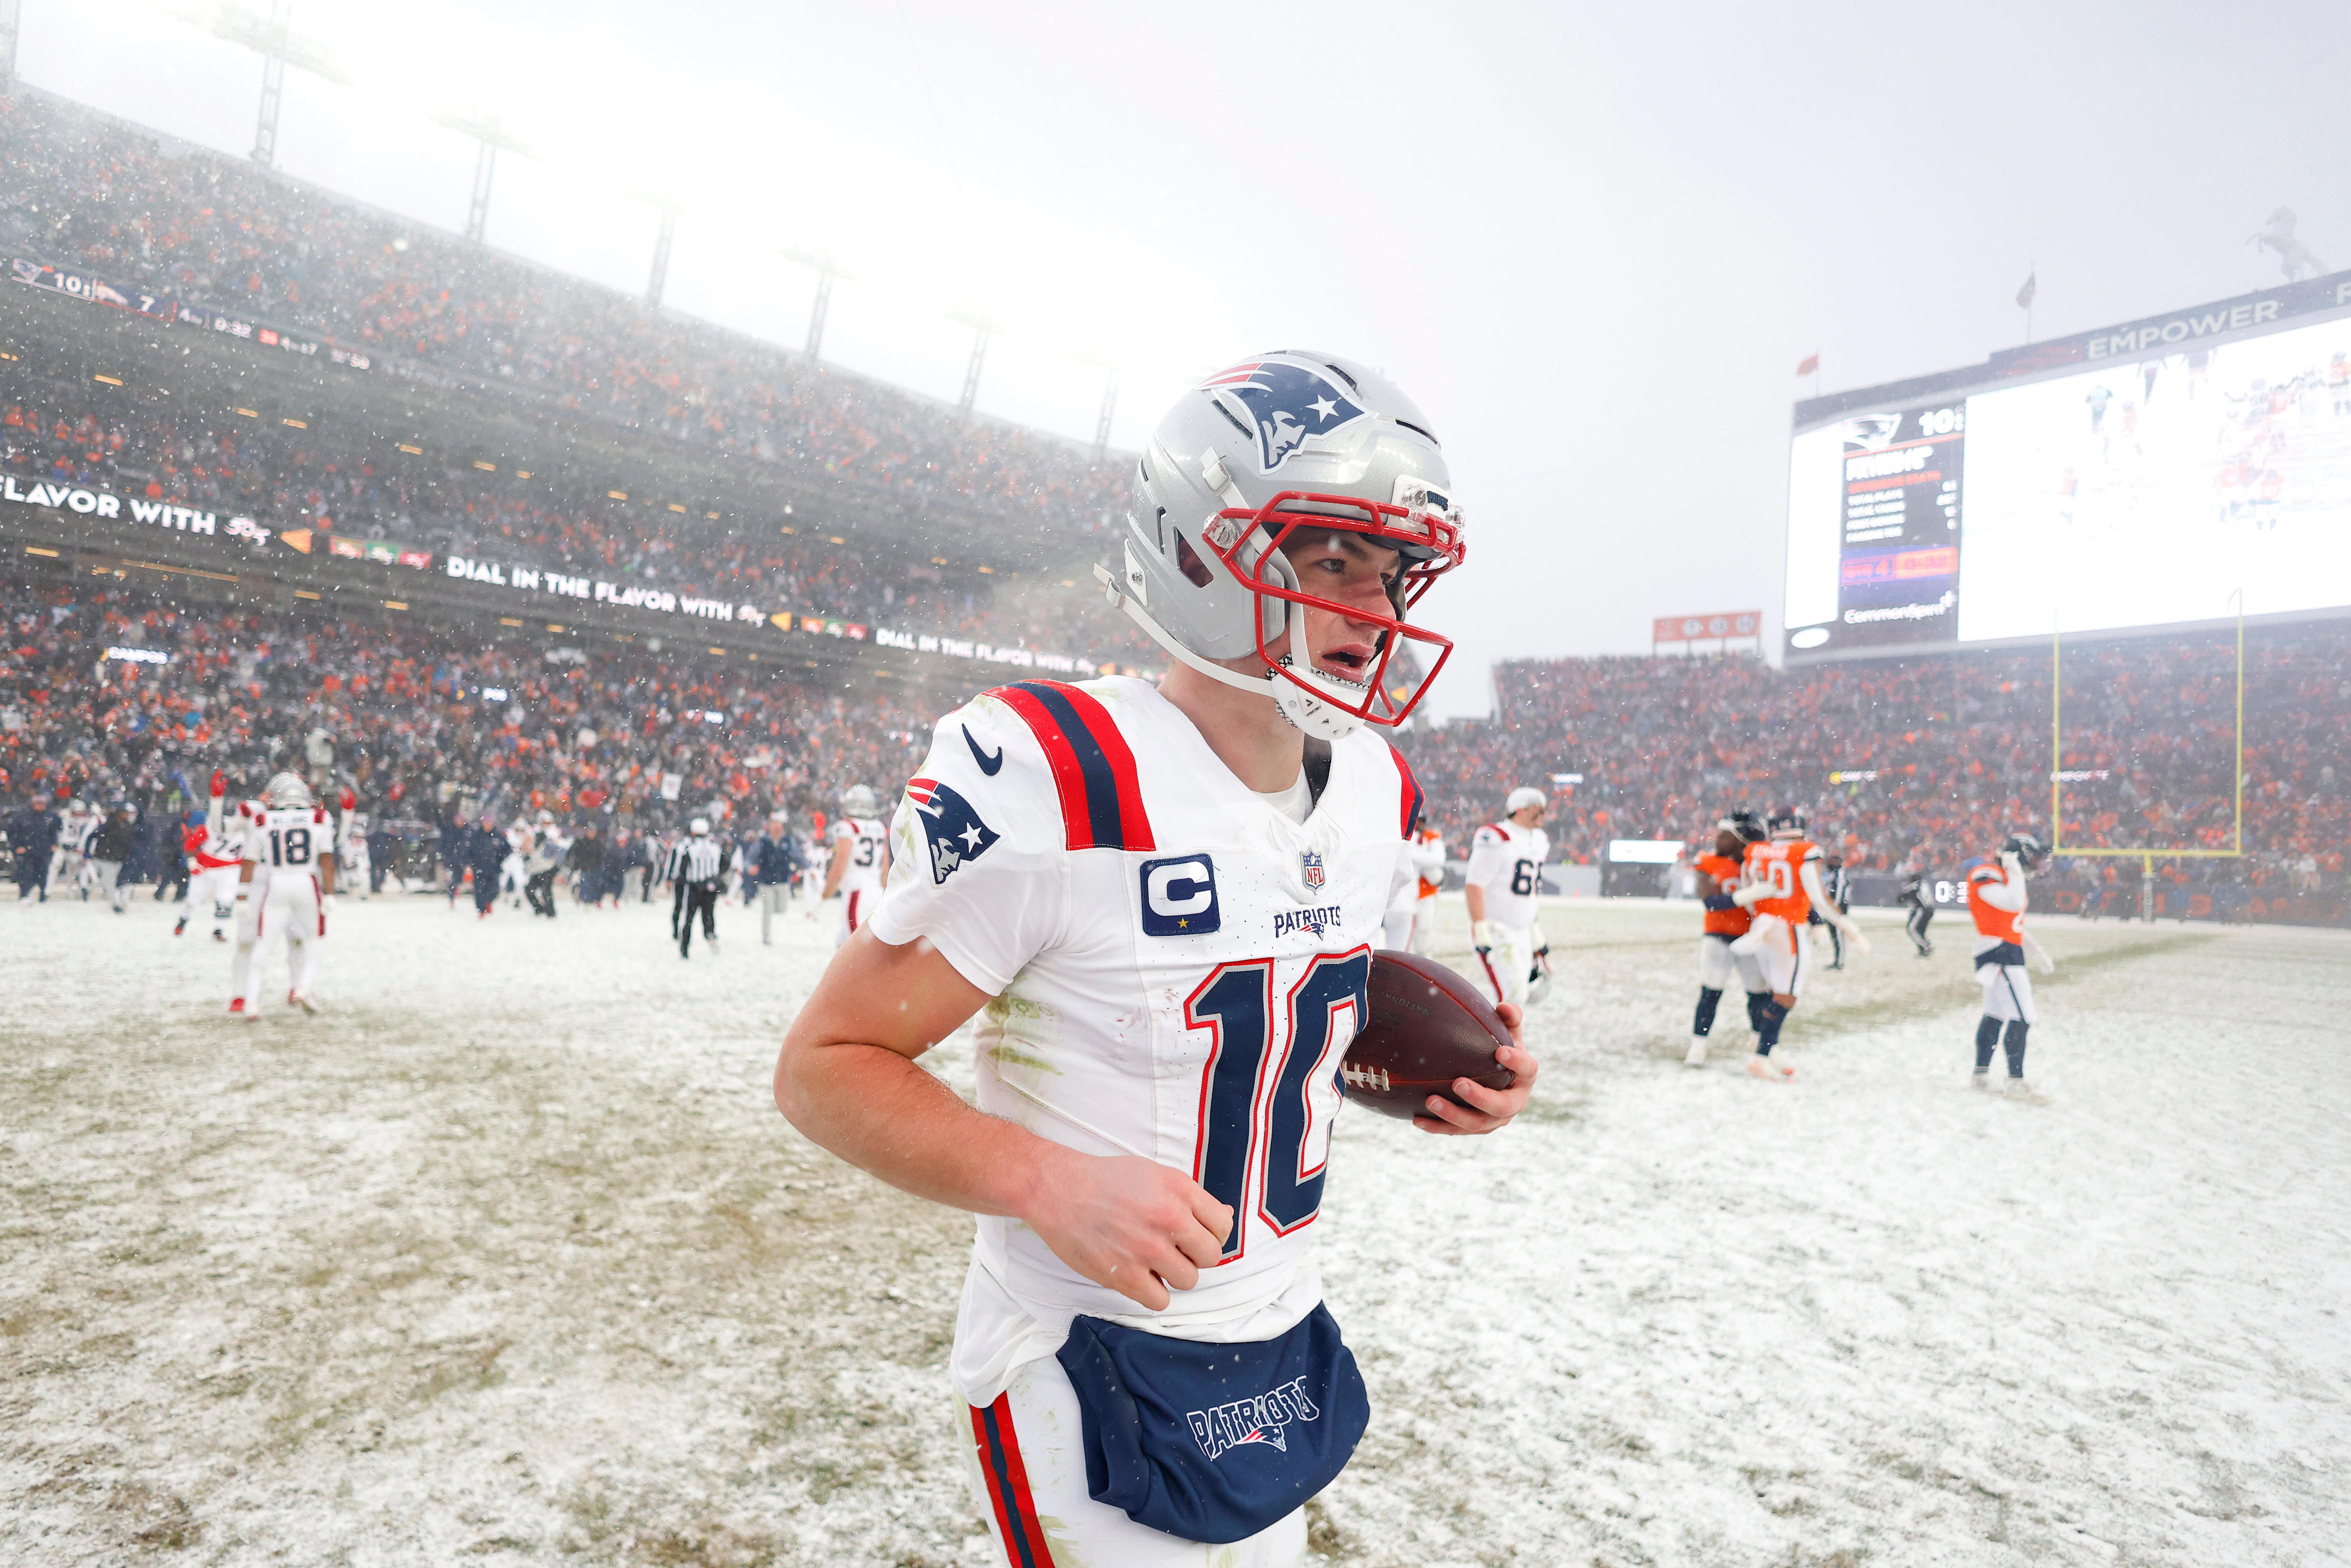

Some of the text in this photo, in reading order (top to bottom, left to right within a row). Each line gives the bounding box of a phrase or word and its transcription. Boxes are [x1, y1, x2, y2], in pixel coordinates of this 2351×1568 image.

[54, 272, 82, 293] 10
[140, 295, 155, 312] 7
[2088, 300, 2279, 360] EMPOWER
[129, 498, 217, 536] WITH
[447, 555, 507, 585] DIAL
[511, 567, 541, 590] IN
[544, 572, 590, 599] THE
[595, 581, 676, 613] FLAVOR
[680, 595, 733, 622] WITH
[876, 627, 917, 650] DIAL
[918, 634, 938, 652] IN
[940, 637, 974, 659] THE
[975, 643, 1033, 667] FLAVOR
[1035, 652, 1073, 673] WITH
[269, 829, 310, 866] 18
[1148, 861, 1212, 916] C
[1306, 866, 1325, 885] NFL
[1273, 905, 1341, 938] PATRIOTS
[1380, 990, 1433, 1016] NATIONAL
[1184, 943, 1371, 1267] 10
[1186, 1375, 1320, 1462] PATRIOTS
